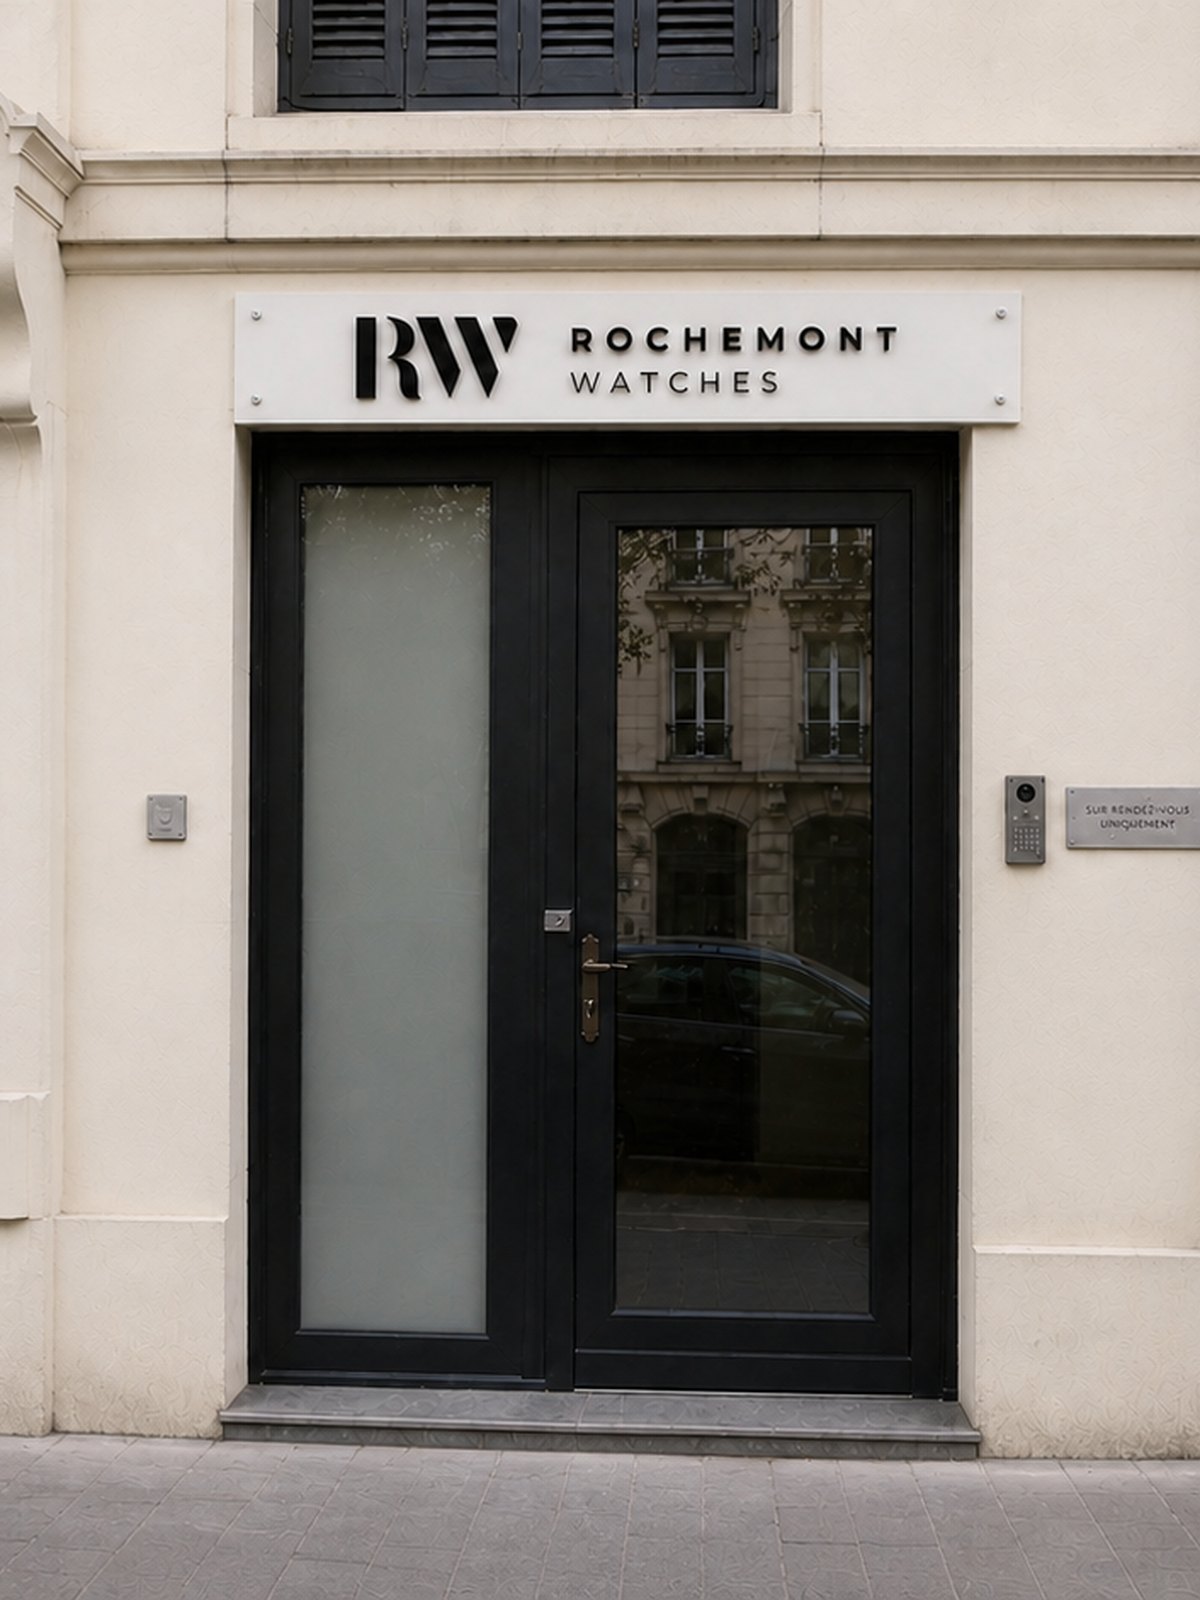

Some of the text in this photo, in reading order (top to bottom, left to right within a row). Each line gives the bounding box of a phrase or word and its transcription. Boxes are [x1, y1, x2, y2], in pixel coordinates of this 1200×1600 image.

[571, 326, 897, 355] ROCHEMONT
[356, 316, 518, 402] RW
[571, 371, 778, 394] WATCHES
[1085, 804, 1108, 815] SUR
[1100, 819, 1175, 831] UNIQUEMENT
